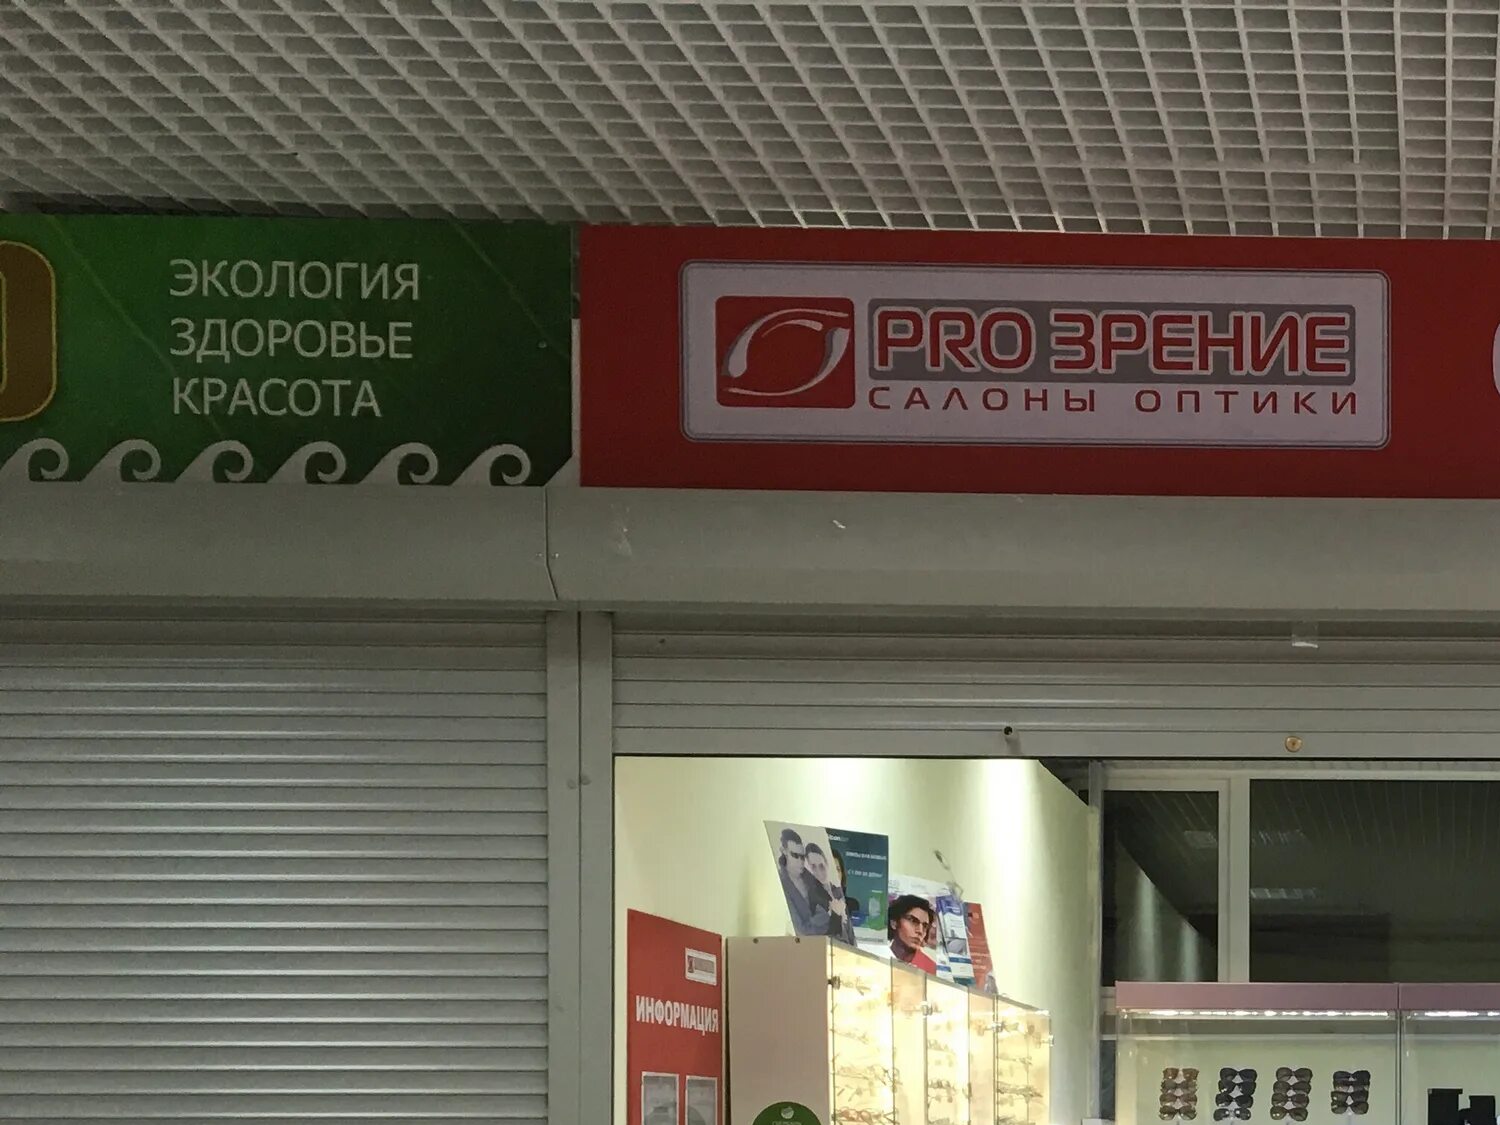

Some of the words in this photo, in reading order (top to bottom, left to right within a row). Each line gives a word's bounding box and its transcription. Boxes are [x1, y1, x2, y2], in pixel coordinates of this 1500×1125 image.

[168, 258, 420, 301] ЭКОЛОГИЯ
[168, 318, 413, 363] ЗДОРОВЬЕ
[1050, 311, 1352, 375] ЗРЕНИЕ
[172, 378, 383, 418] КРАСОТА
[868, 387, 1096, 413] САЛОНЫ
[1134, 390, 1357, 415] ОПТИКИ
[635, 994, 719, 1037] ИНФОРМАЦИЯ
